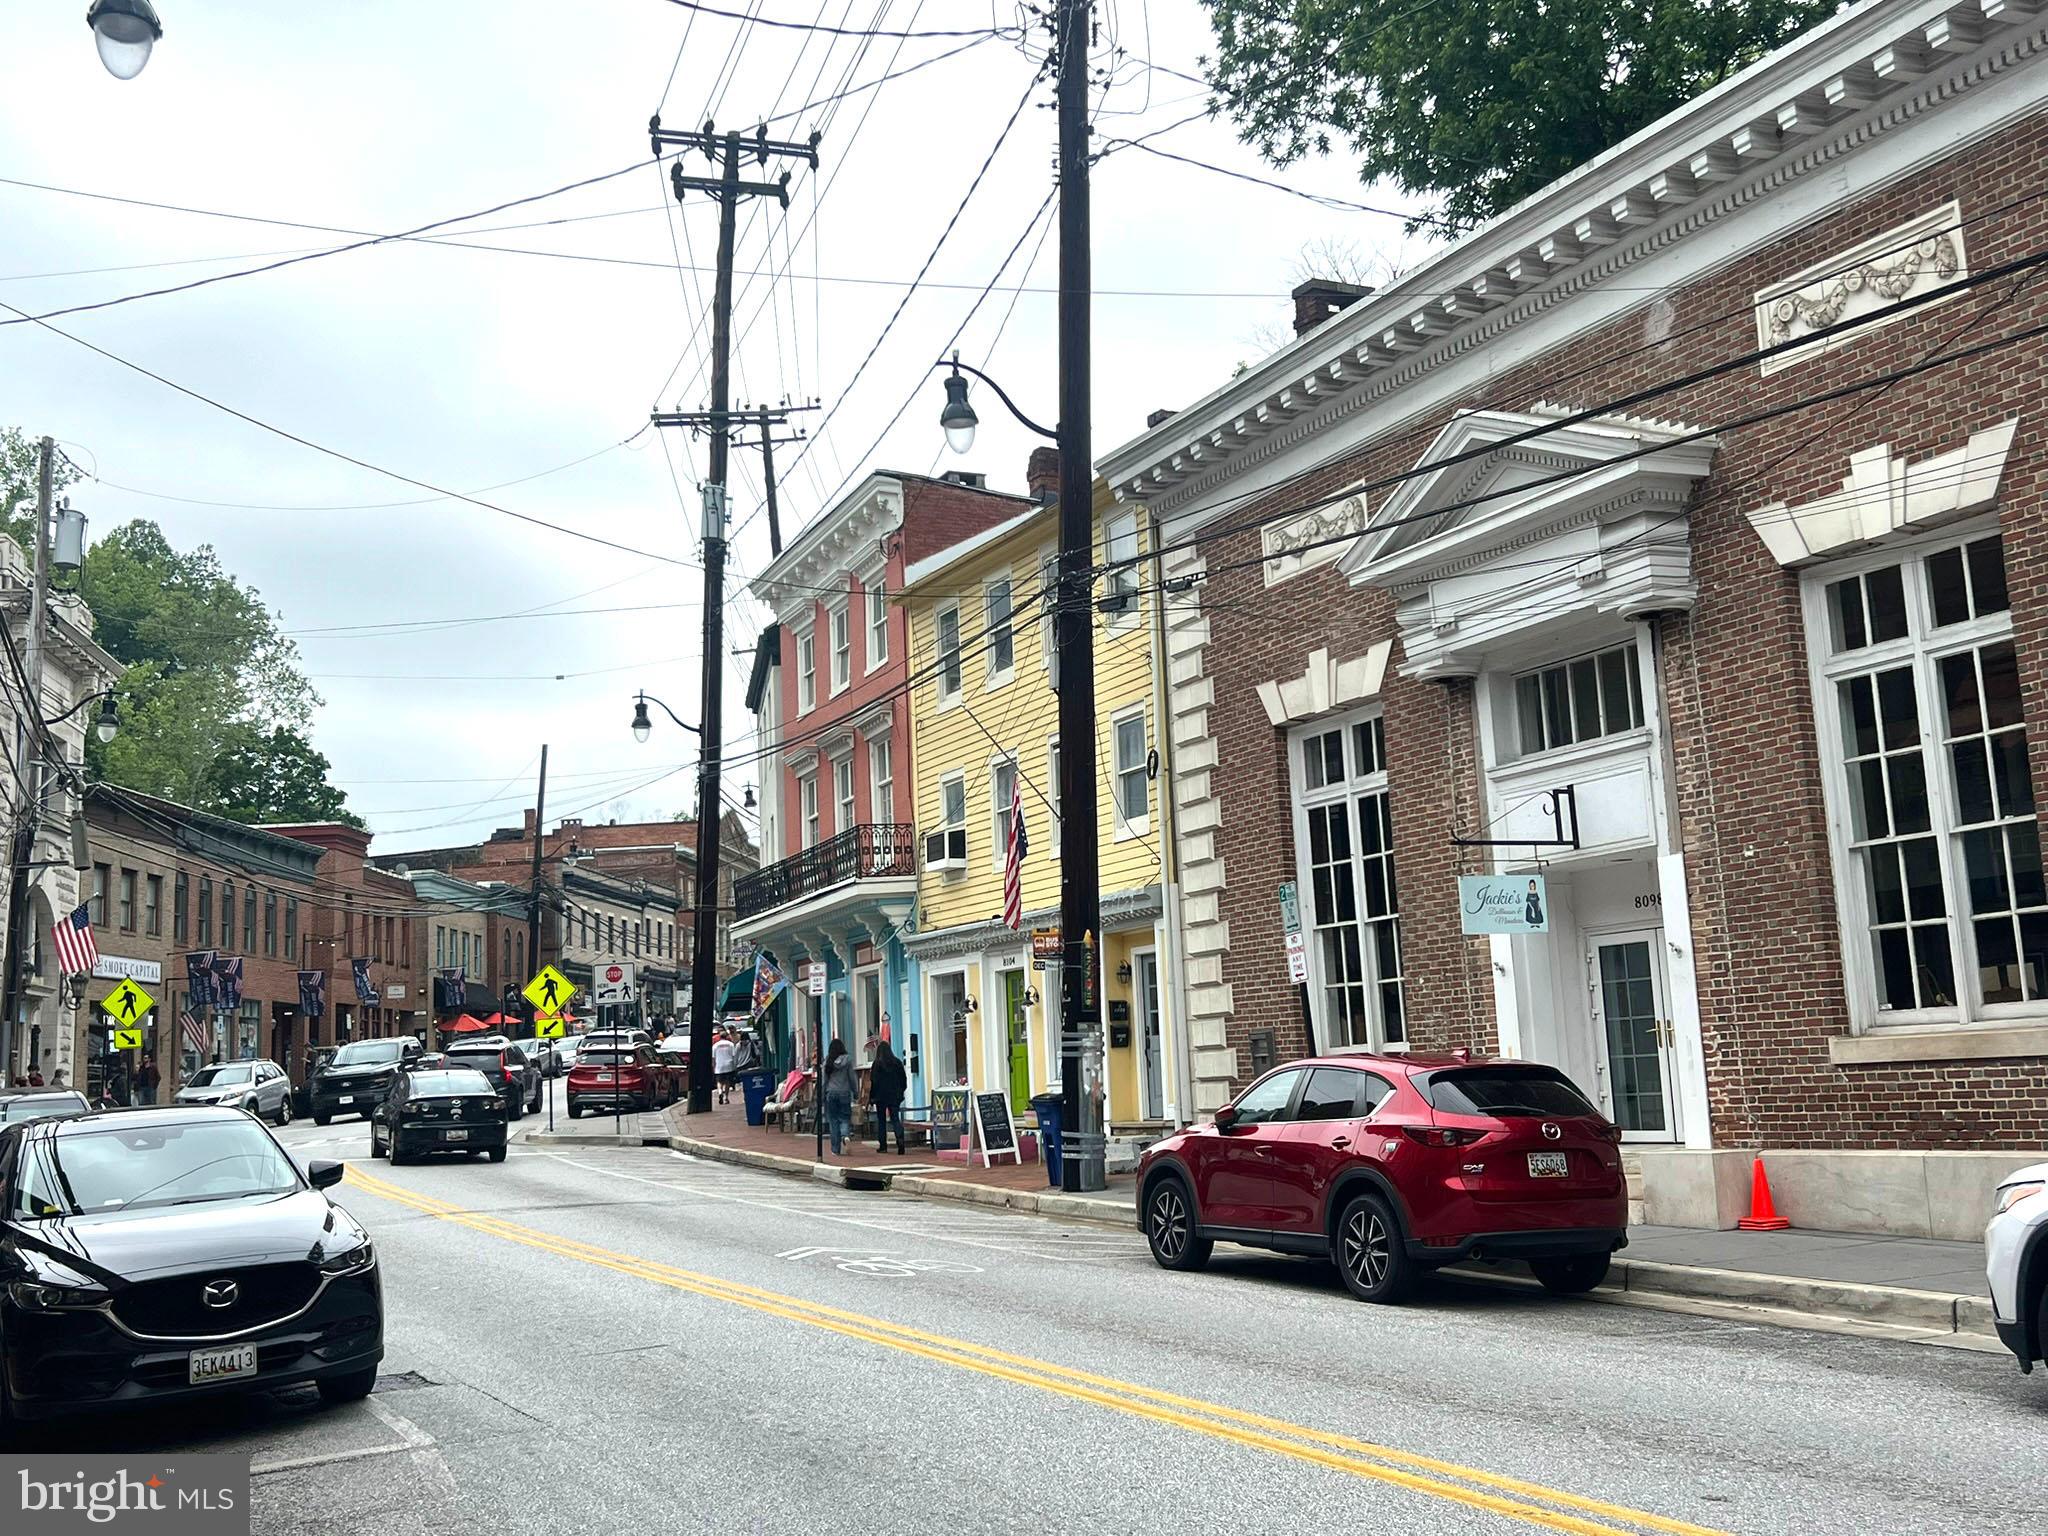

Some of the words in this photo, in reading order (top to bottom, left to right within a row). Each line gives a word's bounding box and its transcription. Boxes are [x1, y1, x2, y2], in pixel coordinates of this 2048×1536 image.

[1280, 886, 1286, 900] 2
[1465, 884, 1521, 915] Jackie's
[1634, 892, 1662, 909] 8098
[104, 960, 128, 975] SMOKE
[129, 963, 159, 979] CAPITAL
[1002, 956, 1016, 967] 8104
[606, 970, 622, 978] STOP
[193, 1352, 253, 1377] 3EK4413
